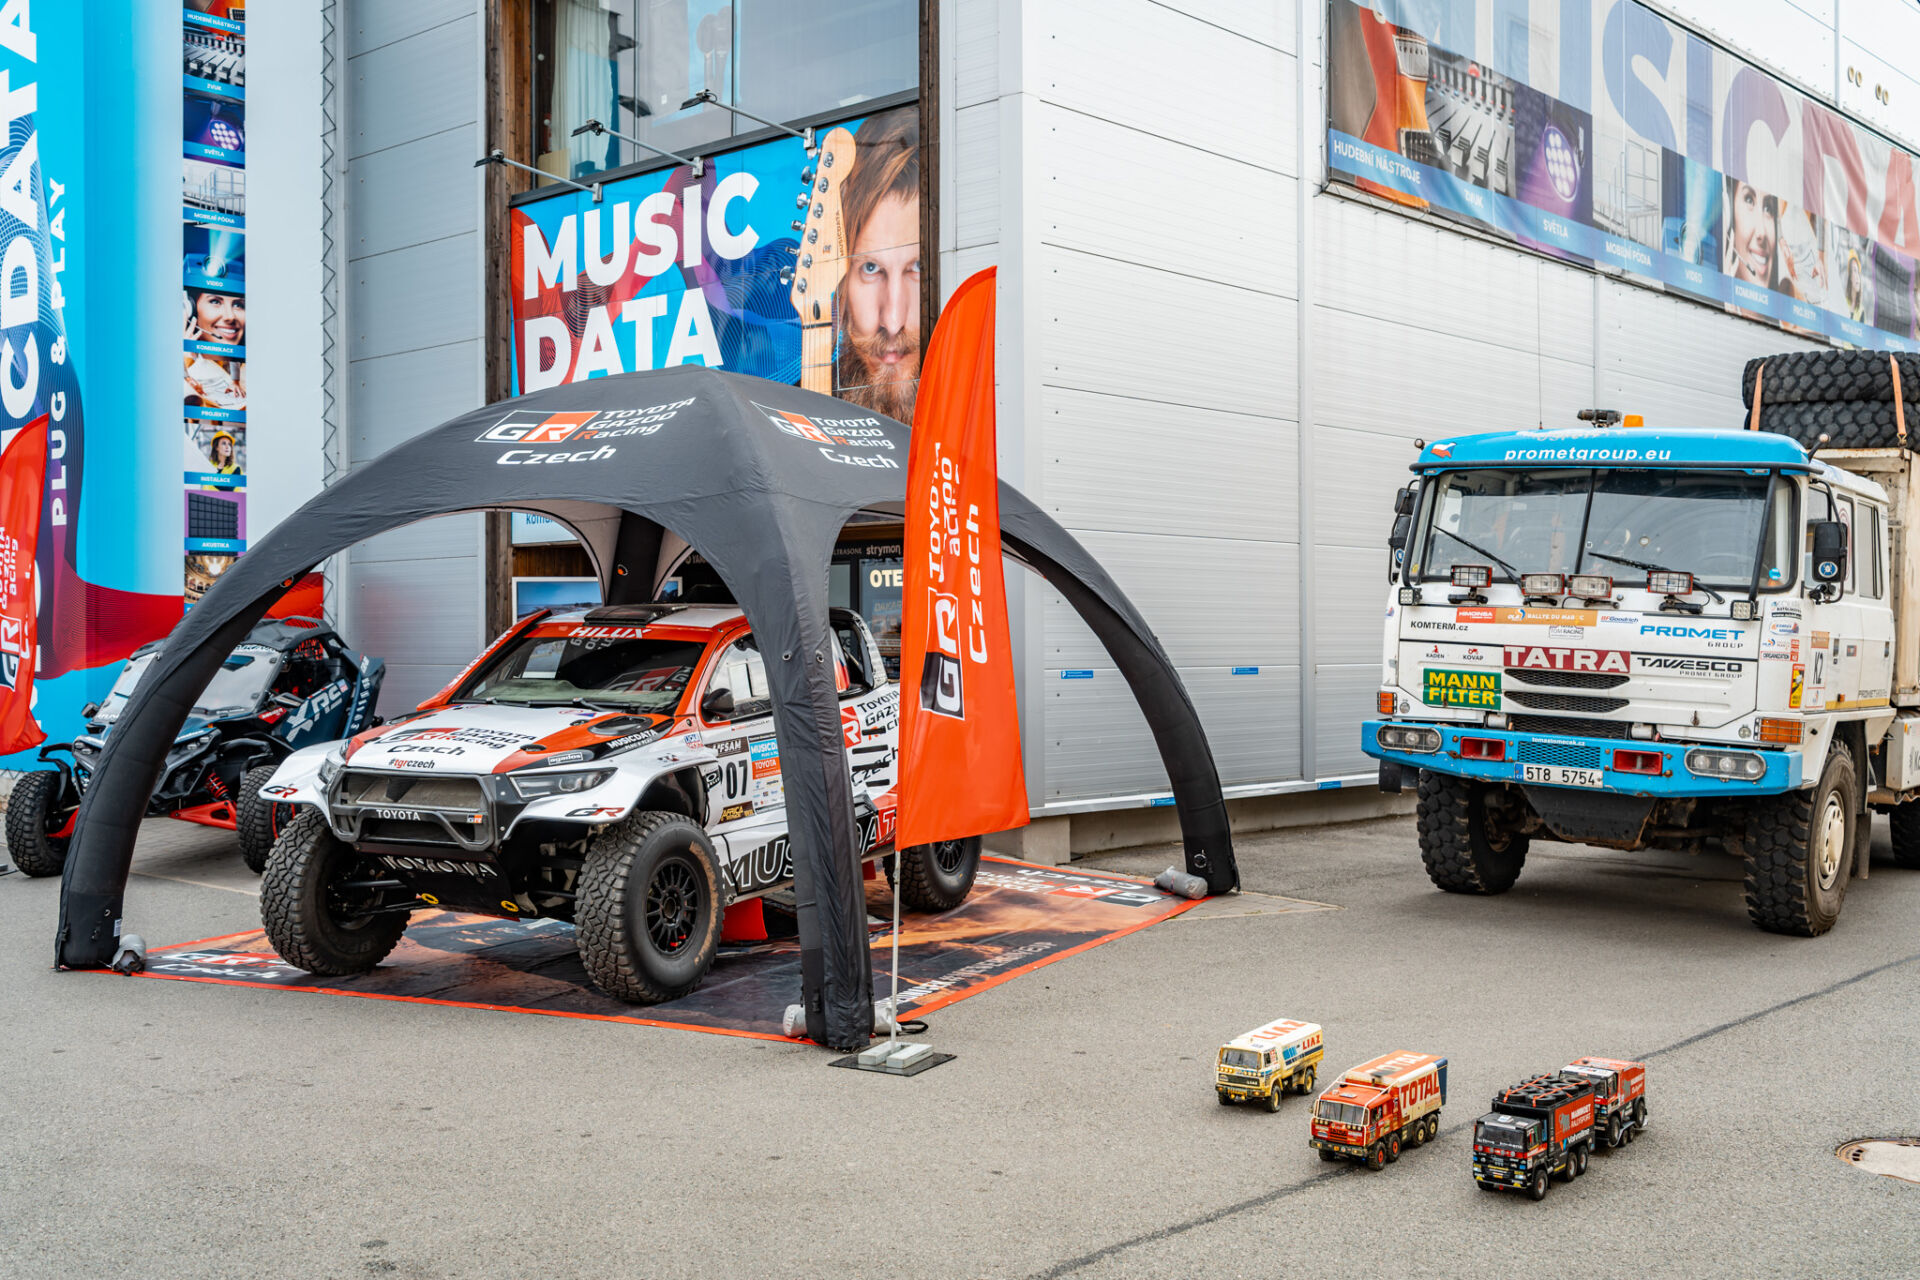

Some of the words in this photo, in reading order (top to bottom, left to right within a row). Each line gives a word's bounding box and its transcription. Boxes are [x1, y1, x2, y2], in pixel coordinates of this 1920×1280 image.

[187, 13, 212, 25] HUDEBNÍ
[212, 18, 241, 31] NÁSTROJE
[206, 83, 222, 91] ZVUK
[204, 147, 225, 158] SVĚTLA
[1333, 139, 1374, 166] HUDEBNÍ
[1375, 150, 1421, 184] NÁSTROJE
[1463, 188, 1484, 209] ZVUK
[524, 172, 760, 300] MUSIC
[1543, 218, 1569, 239] SVĚTLA
[50, 177, 65, 309] PLAY
[206, 280, 224, 288] VIDEO
[1685, 269, 1703, 284] VIDEO
[51, 336, 66, 365] &
[524, 288, 725, 395] DATA
[201, 410, 230, 419] PROJEKTY
[602, 396, 698, 421] TOYOTA
[586, 410, 678, 431] GAZOO
[767, 415, 832, 444] GR
[809, 416, 881, 429] TOYOTA
[485, 422, 580, 442] GR
[572, 423, 664, 442] Racing
[822, 426, 884, 438] GAZOO
[832, 435, 896, 451] Racing
[51, 391, 67, 526] PLUG
[496, 444, 618, 466] Czech
[818, 447, 900, 470] Czech
[1504, 446, 1672, 462] prometgroup.eu
[202, 541, 230, 549] AKUSTIKA
[866, 544, 901, 557] strymon
[869, 568, 904, 588] OTE
[966, 503, 989, 665] Czech
[1410, 621, 1469, 632] KOMTERM.cz
[1600, 615, 1639, 624] BFGoodrich
[568, 626, 652, 639] HILUX
[1640, 625, 1745, 641] PROMET
[1707, 641, 1744, 649] GROUP
[1, 619, 21, 692] GR
[934, 599, 962, 714] GR
[1504, 646, 1629, 673] TATRA
[1429, 671, 1496, 690] MANN
[1679, 670, 1712, 678] PROMET
[1429, 687, 1496, 706] FILTER
[437, 735, 507, 750] Racing
[449, 731, 520, 745] GAZOO
[465, 727, 538, 742] TOYOTA
[606, 728, 660, 750] MUSICDATA
[387, 744, 466, 756] Czech
[388, 758, 436, 770] #tgrczech
[1526, 766, 1552, 782] 5T8
[1562, 769, 1596, 786] 5754
[376, 809, 422, 821] TOYOTA
[565, 806, 625, 818] GR
[1252, 1020, 1307, 1040] LIAZ
[1302, 1034, 1321, 1051] LIAZ
[1400, 1071, 1441, 1110] TOTAL
